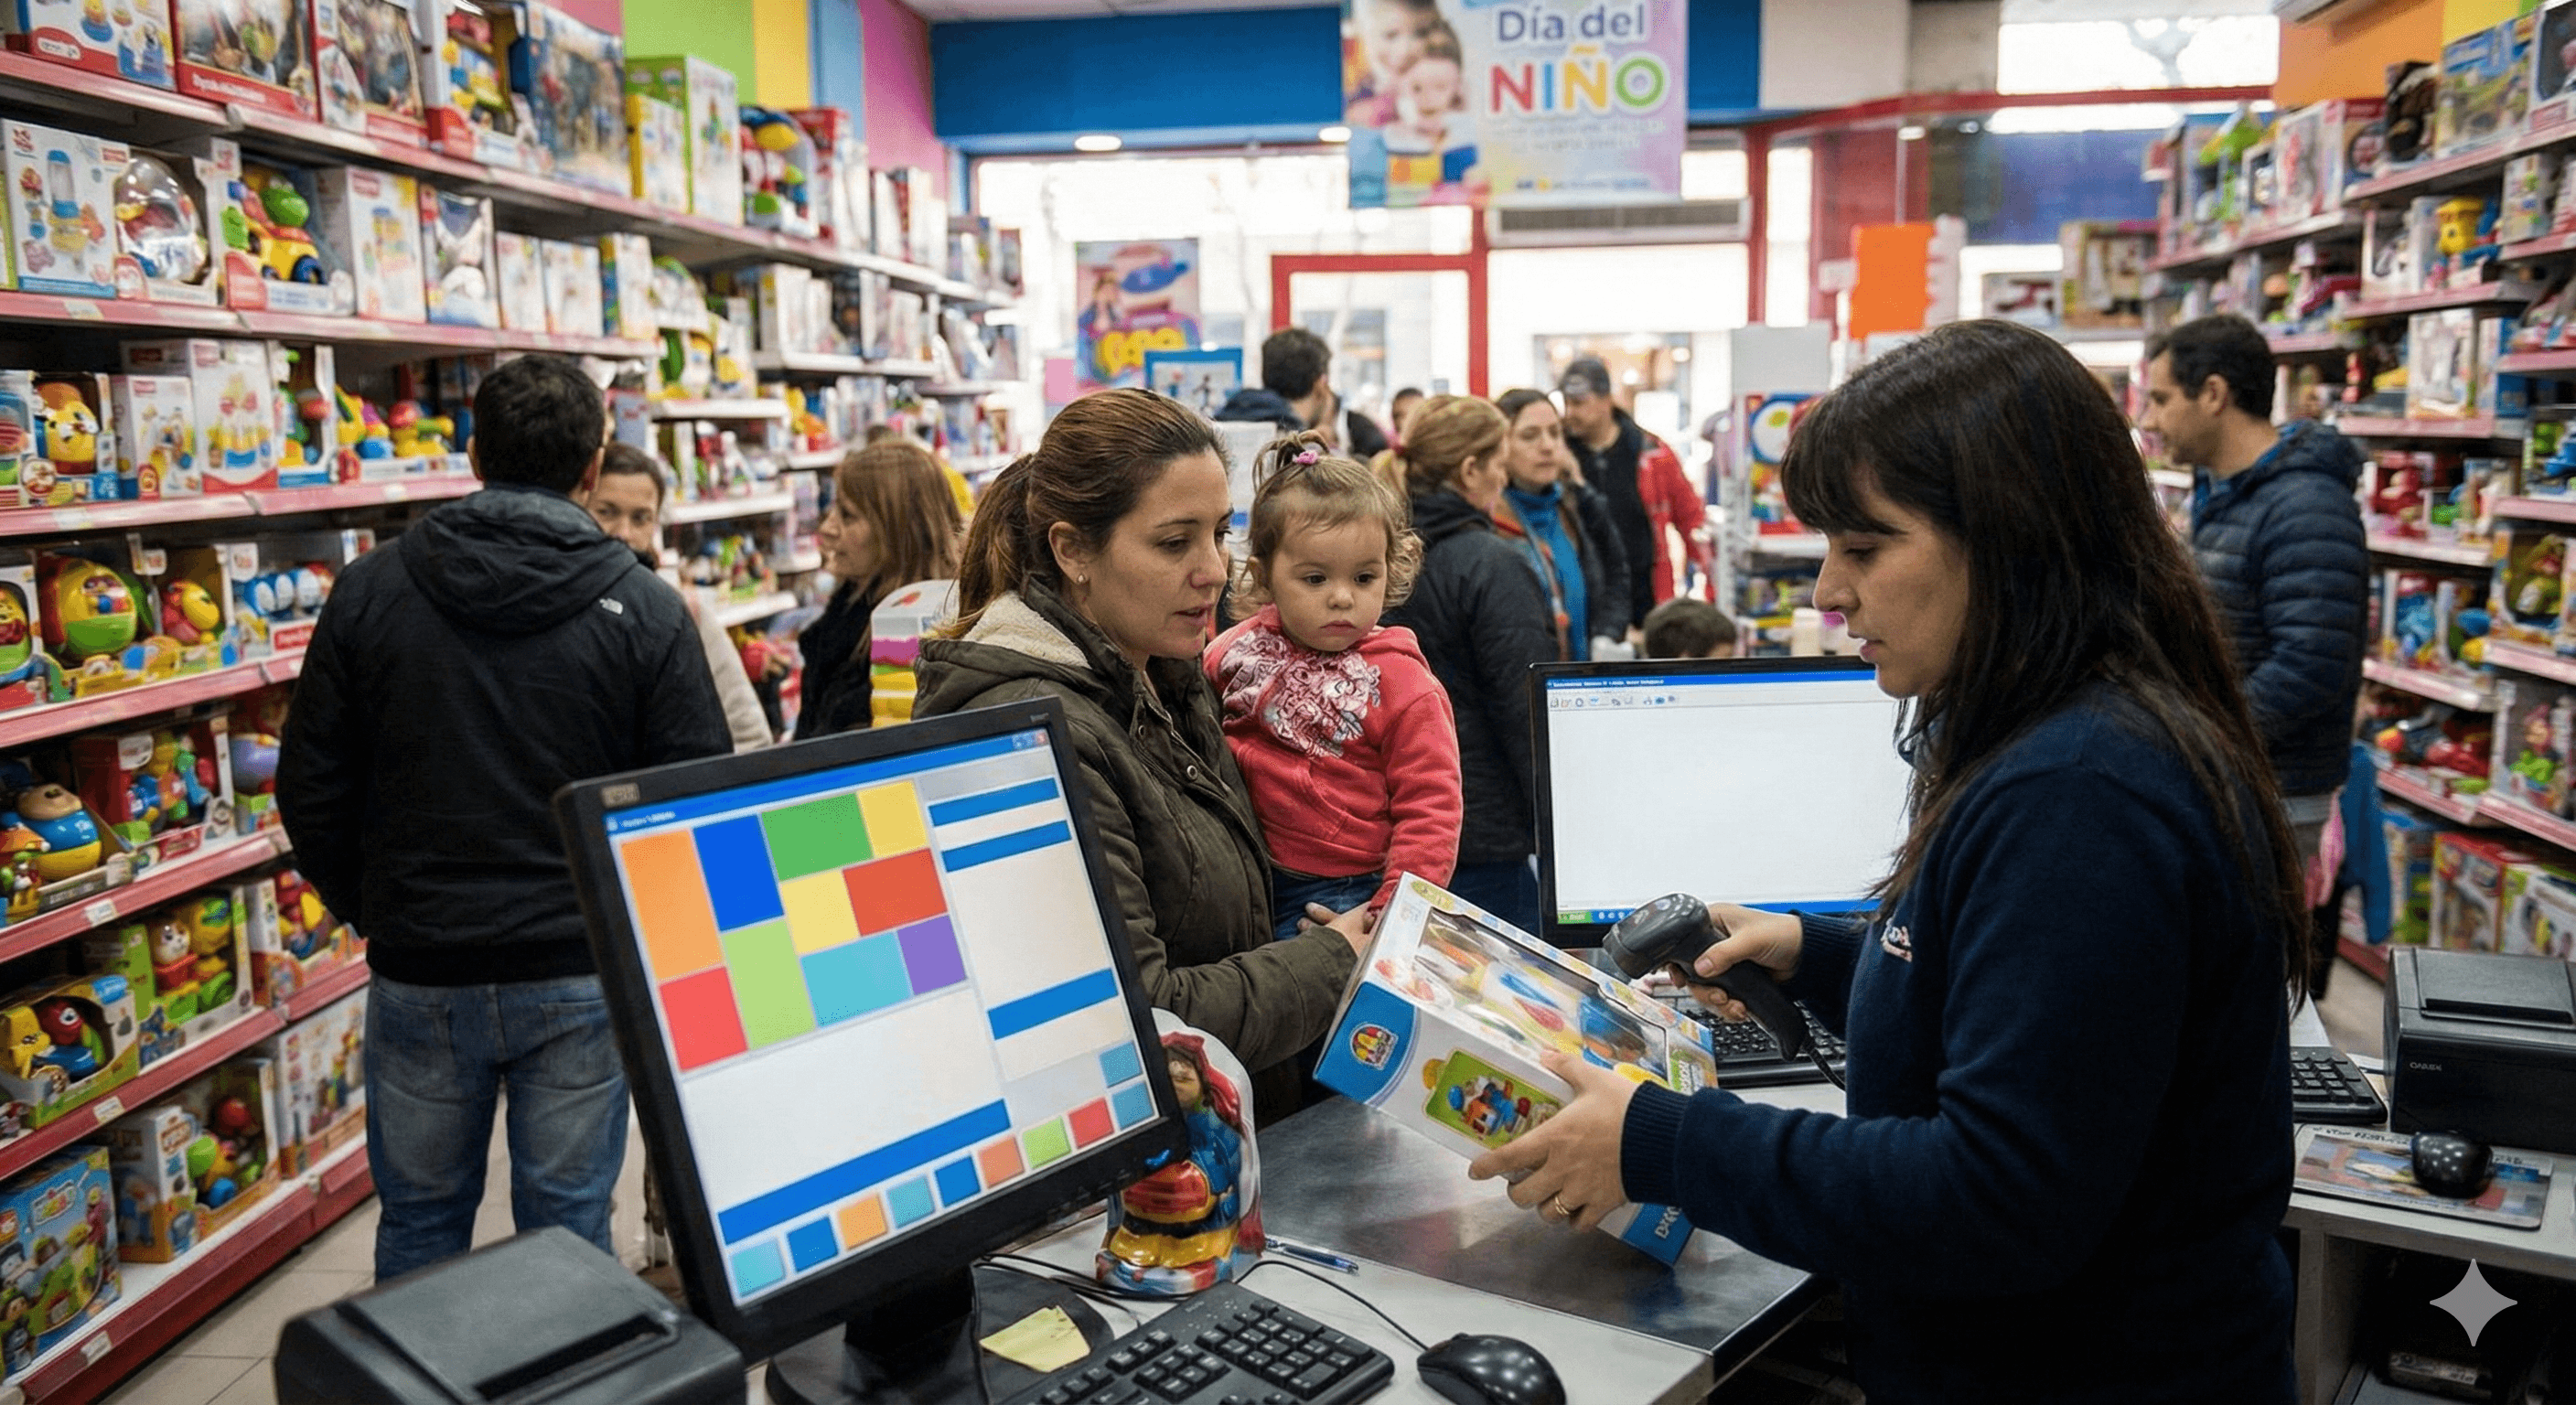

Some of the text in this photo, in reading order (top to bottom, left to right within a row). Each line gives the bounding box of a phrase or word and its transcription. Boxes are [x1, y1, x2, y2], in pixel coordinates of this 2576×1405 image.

[1498, 4, 1644, 41] Día del
[1490, 43, 1667, 113] NIÑO
